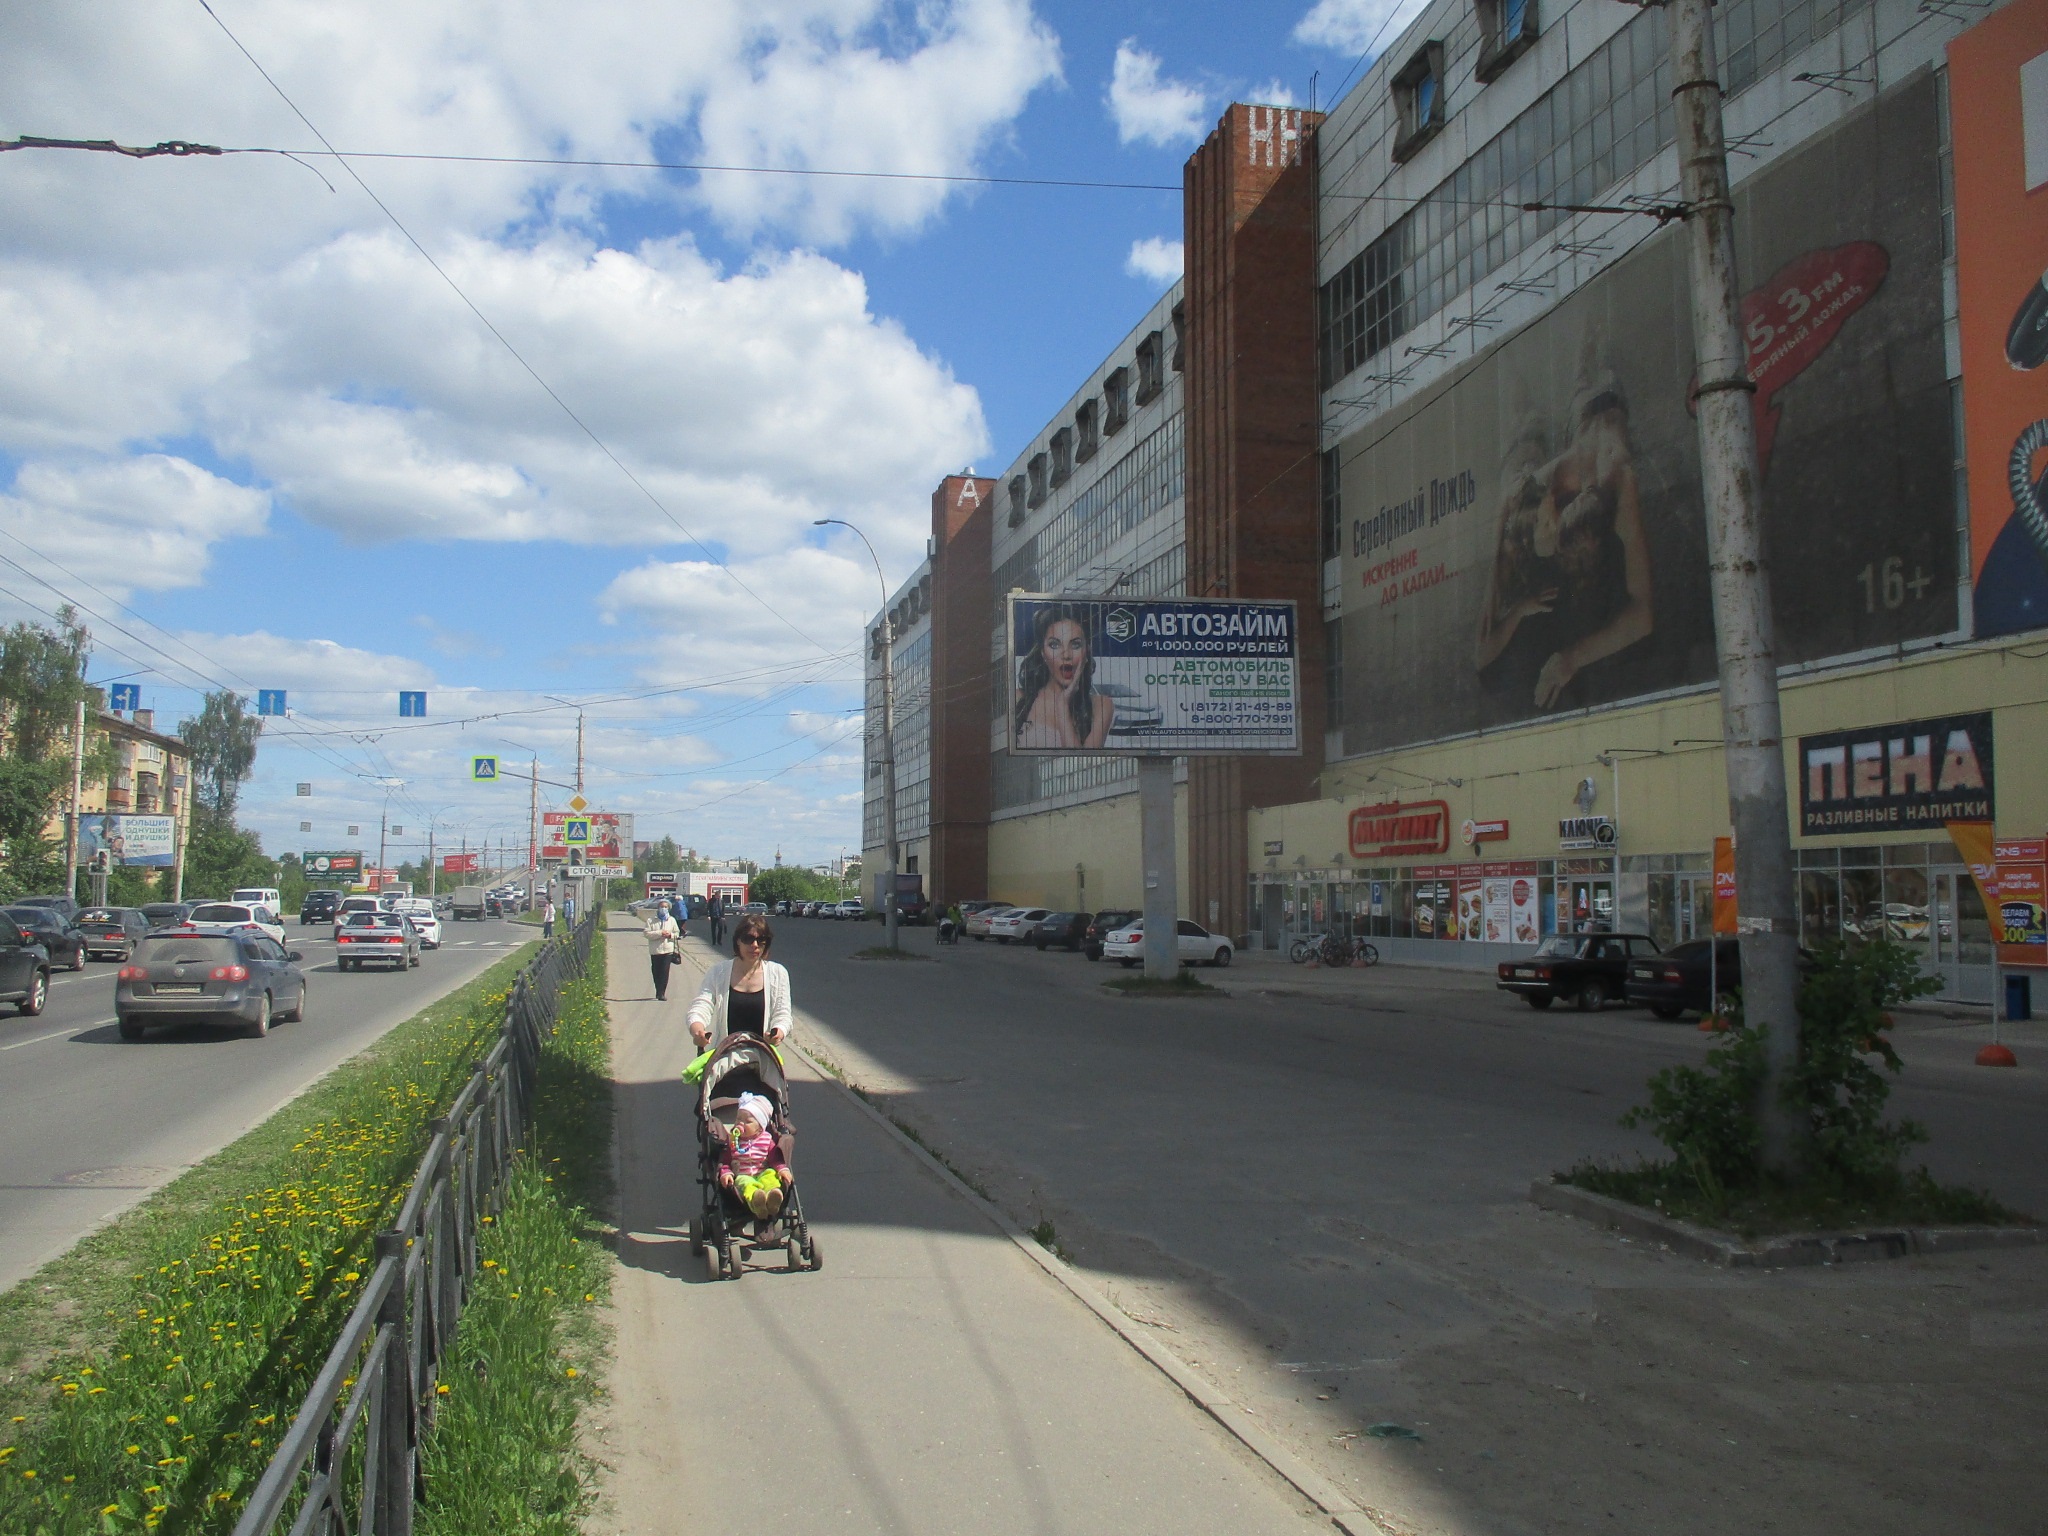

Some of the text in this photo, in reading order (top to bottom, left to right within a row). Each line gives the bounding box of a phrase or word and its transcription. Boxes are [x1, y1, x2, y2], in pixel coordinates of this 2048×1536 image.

[1811, 271, 1844, 302] FM
[1747, 285, 1863, 382] ЕБРЯНЫЙ ДОЖДЬ
[1353, 469, 1475, 559] Серебряный Дождь
[1362, 548, 1418, 589] ИСКРЕННЕ
[1380, 583, 1398, 609] ДО
[1857, 556, 1931, 613] 16+
[1142, 610, 1288, 636] АВТОЗАЙМ
[1154, 641, 1224, 651] 1.000.000
[1227, 640, 1288, 652] РУБЛЕЙ
[1172, 660, 1290, 672] АВТОМОБИЛЬ
[1144, 674, 1290, 686] ОСТАЕТСЯ У ВАС
[1191, 702, 1292, 712] (8172) 21-49-89
[1191, 714, 1292, 724] 8-800-770-7991
[1807, 729, 1985, 802] ПЕНА
[1807, 801, 1988, 826] РАЗЛИВНЫЕ НАПИТКИ
[1355, 813, 1441, 844] МАГНИТ
[1995, 847, 2020, 857] DNS
[2004, 918, 2028, 928] КИДКУ
